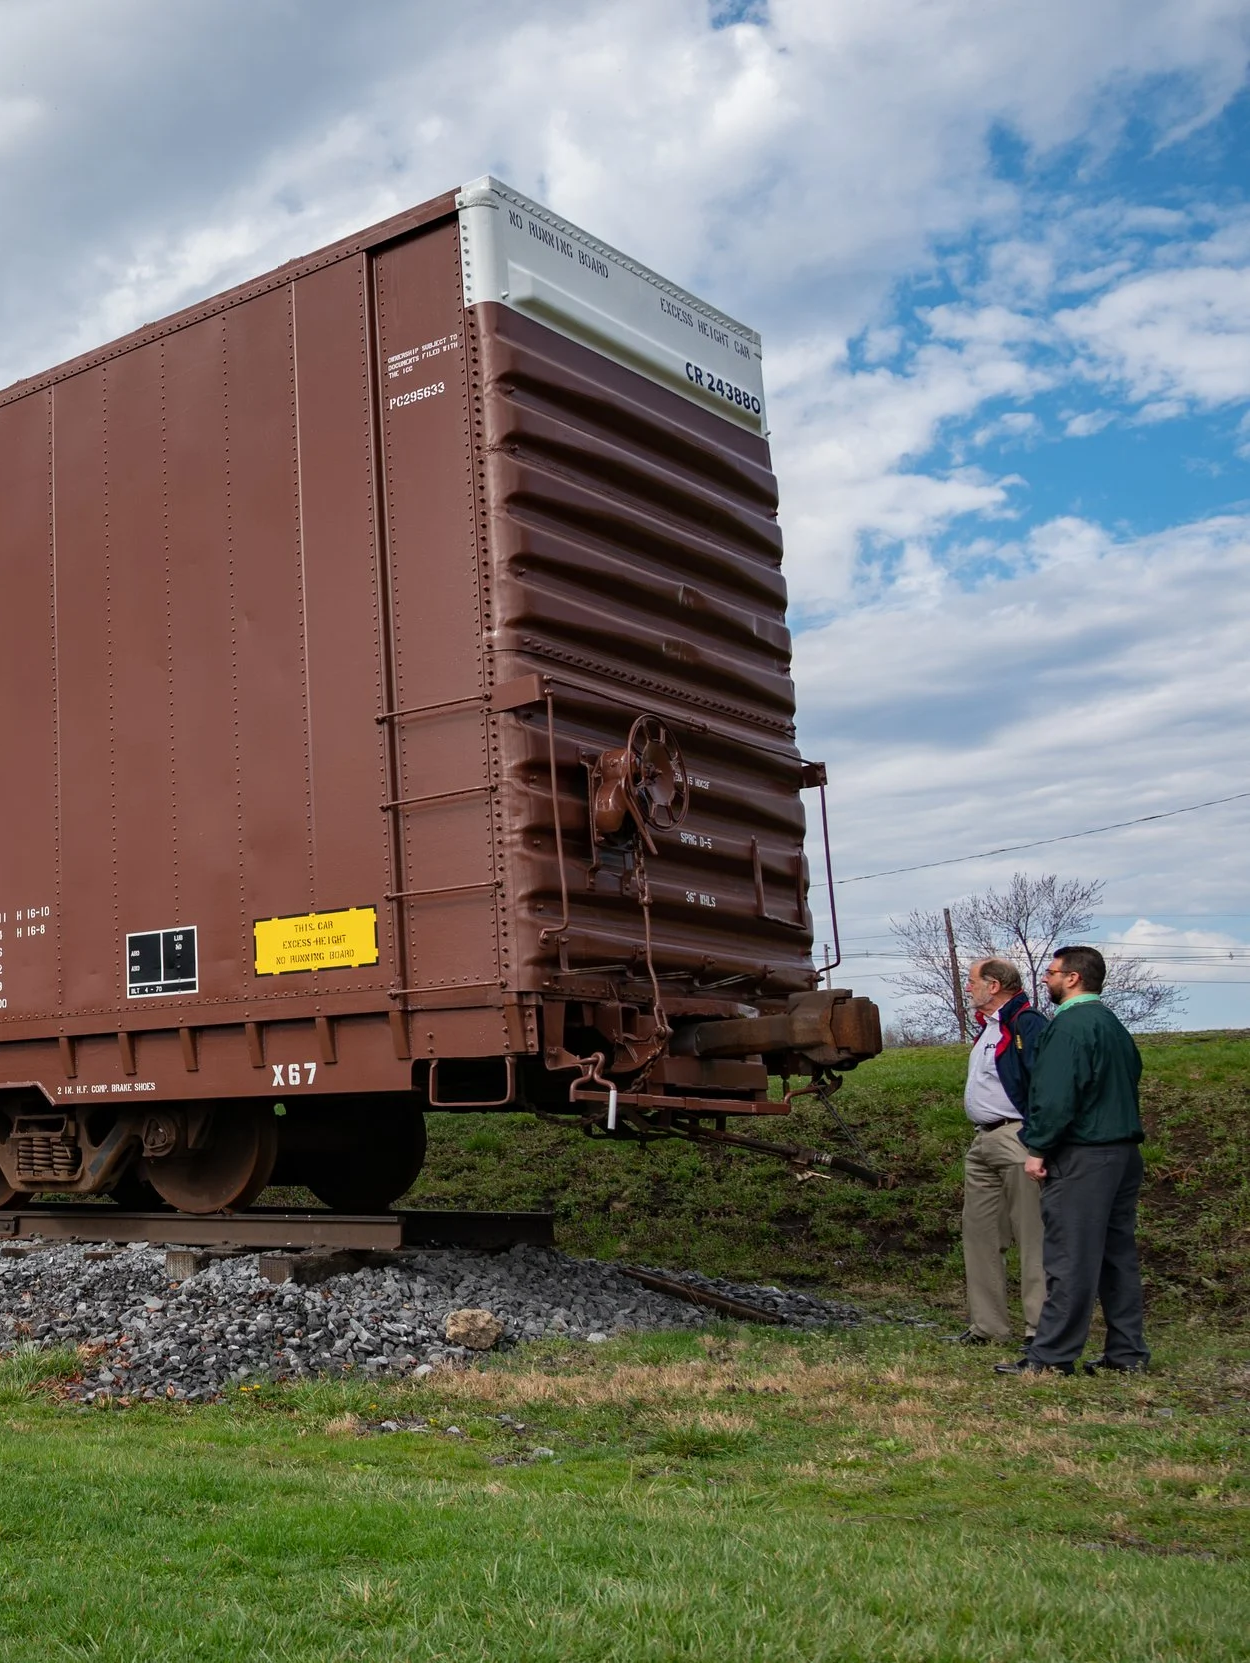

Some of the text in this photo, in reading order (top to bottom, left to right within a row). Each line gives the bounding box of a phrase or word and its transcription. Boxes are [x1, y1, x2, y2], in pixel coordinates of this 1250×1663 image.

[509, 210, 609, 279] NO RUNNING BOARD
[660, 297, 751, 360] EXCESS HEIGHT CAR
[422, 337, 447, 351] SUBJECT
[449, 334, 458, 342] TO
[443, 341, 458, 352] WITH
[388, 370, 399, 379] THE
[389, 381, 445, 410] PC295633
[684, 361, 761, 415] CR 243880
[16, 910, 22, 920] H
[27, 906, 50, 919] 16-10
[16, 927, 22, 938] H
[27, 924, 46, 936] 16-8
[294, 920, 334, 933] THIS CAR
[282, 938, 312, 950] EXCESS
[275, 949, 355, 965] NO RUNNING BOARD
[272, 1062, 317, 1087] X67
[57, 1086, 62, 1095] 2
[76, 1085, 89, 1093] H.F.
[91, 1084, 109, 1093] COMP.
[111, 1083, 132, 1092] BRAKE
[134, 1082, 156, 1091] SHOES
